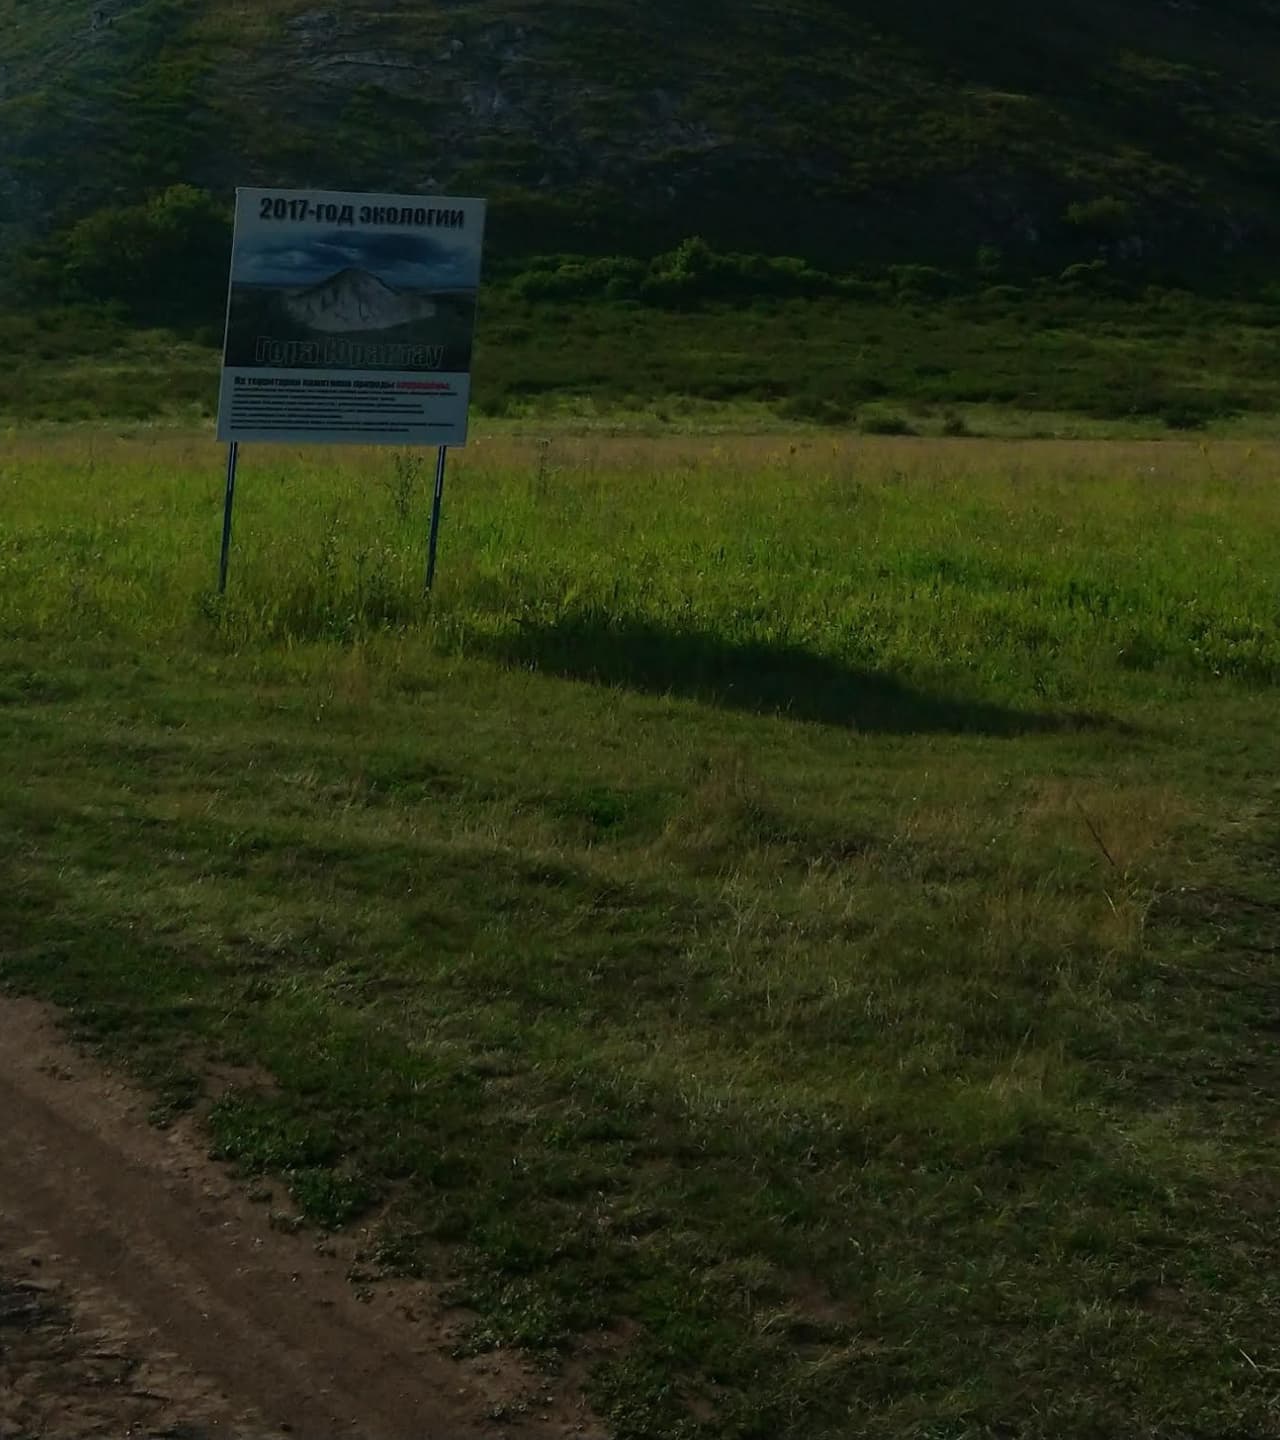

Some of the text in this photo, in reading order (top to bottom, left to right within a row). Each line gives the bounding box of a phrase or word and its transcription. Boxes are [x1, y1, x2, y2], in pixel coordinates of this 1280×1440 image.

[260, 197, 465, 229] 2017-год экологии
[255, 335, 320, 366] Гора
